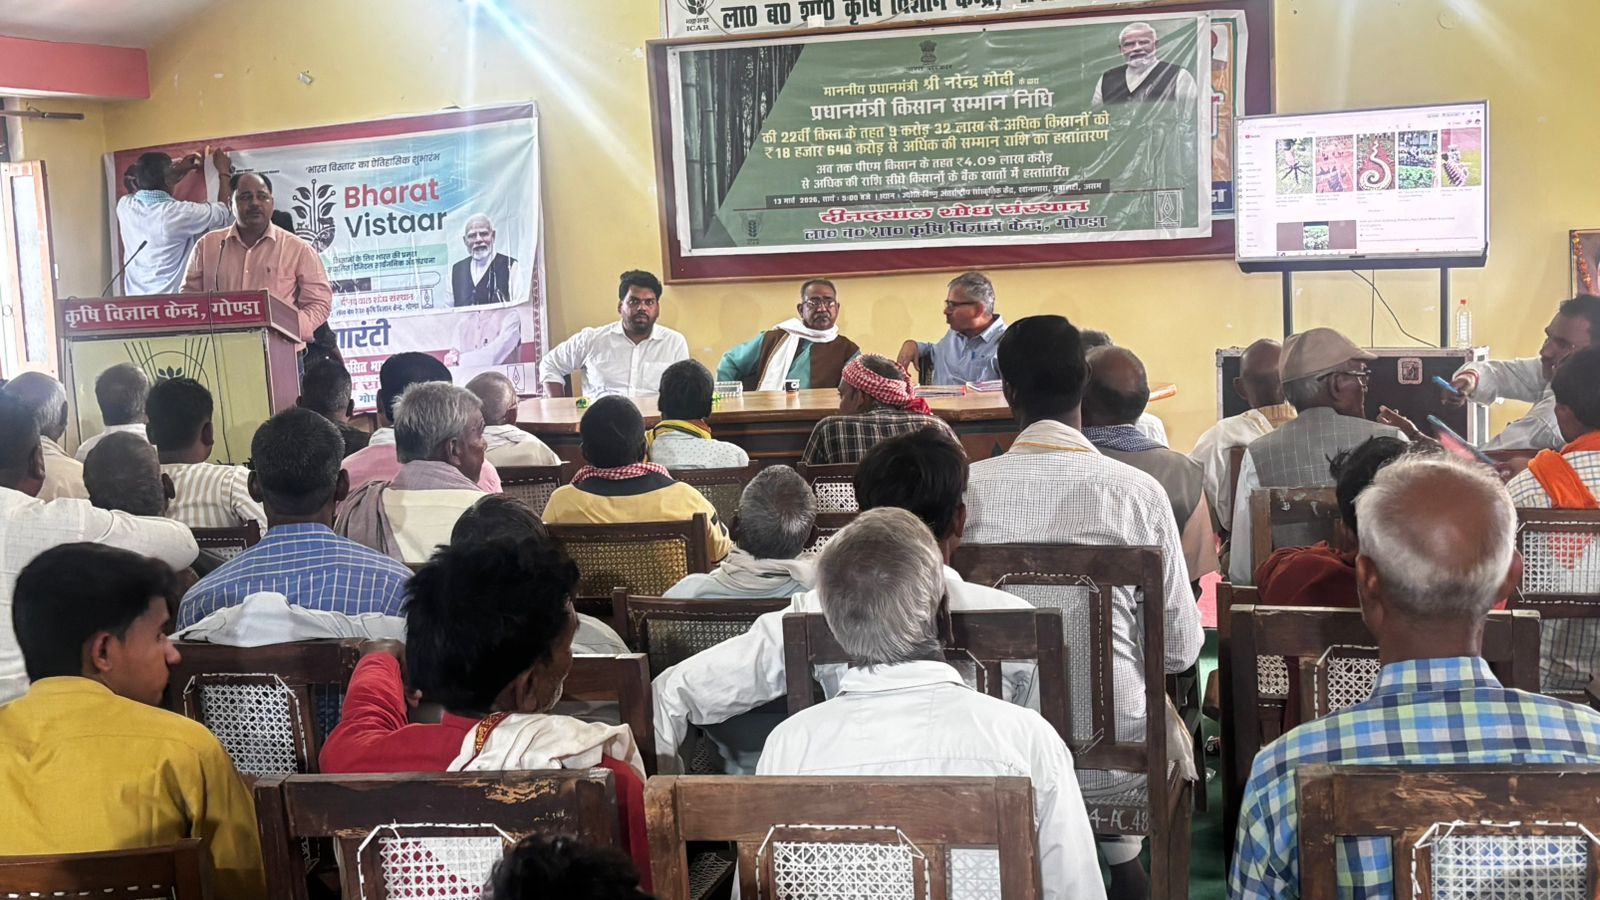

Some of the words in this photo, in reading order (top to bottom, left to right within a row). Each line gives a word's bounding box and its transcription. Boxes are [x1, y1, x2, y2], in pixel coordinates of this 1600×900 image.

[823, 82, 865, 97] माननीय
[869, 79, 919, 95] प्रधानमंत्री
[923, 74, 940, 90] श्री
[944, 72, 979, 89] नरेन्द्र
[982, 70, 1015, 87] मोदी
[810, 98, 887, 121] प्रधानमंत्री
[891, 96, 947, 115] किसान
[951, 94, 1008, 113] सम्मान
[1013, 88, 1055, 108] निधि
[761, 130, 777, 144] की
[814, 127, 842, 141] किस्त
[845, 125, 857, 139] के
[859, 126, 885, 138] तहत
[889, 126, 897, 137] 9
[901, 121, 930, 137] करोड़
[934, 122, 951, 135] 32
[955, 121, 985, 134] लाख
[987, 117, 999, 131] से
[1004, 115, 1042, 131] अधिक
[1044, 111, 1091, 128] किसानों
[1093, 110, 1110, 125] को
[794, 144, 824, 158] हजार
[827, 144, 852, 156] 640
[856, 139, 884, 157] करोड़
[887, 138, 898, 153] से
[903, 138, 939, 152] अधिक
[941, 135, 957, 150] की
[961, 135, 999, 148] सम्मान
[1003, 131, 1030, 147] राशि
[1033, 132, 1049, 145] का
[1052, 128, 1109, 145] हस्तांतरण
[358, 160, 369, 168] का
[371, 155, 410, 168] ऐतिहासिक
[412, 152, 440, 166] शुभारंभ
[816, 163, 833, 174] अब
[836, 162, 853, 173] तक
[855, 160, 881, 172] पीएम
[884, 158, 916, 171] किसान
[919, 156, 930, 169] के
[932, 157, 953, 168] तहत
[956, 155, 996, 167] ₹4.09
[999, 153, 1025, 165] लाख
[1027, 150, 1053, 165] करोड़
[801, 177, 810, 190] से
[813, 176, 843, 189] अधिक
[845, 175, 858, 187] की
[861, 173, 882, 187] राशि
[886, 172, 906, 185] सीधे
[909, 170, 945, 184] किसानों
[948, 168, 958, 182] के
[961, 168, 978, 182] बैंक
[980, 166, 1007, 180] खातों
[1010, 165, 1019, 179] में
[1023, 165, 1070, 178] हस्तांतरित
[344, 177, 440, 209] Bharat
[344, 211, 447, 238] Vistaar
[820, 208, 932, 223] दीनदयाल
[938, 202, 992, 217] शोध
[997, 199, 1089, 216] संस्थान
[909, 222, 944, 239] कृषि
[949, 219, 1003, 234] विज्ञान
[1055, 215, 1107, 229] गोण्डा
[65, 304, 100, 328] कृषि
[104, 303, 160, 322] विज्ञान
[163, 300, 206, 320] केन्द्र,
[211, 298, 261, 317] गोण्डा
